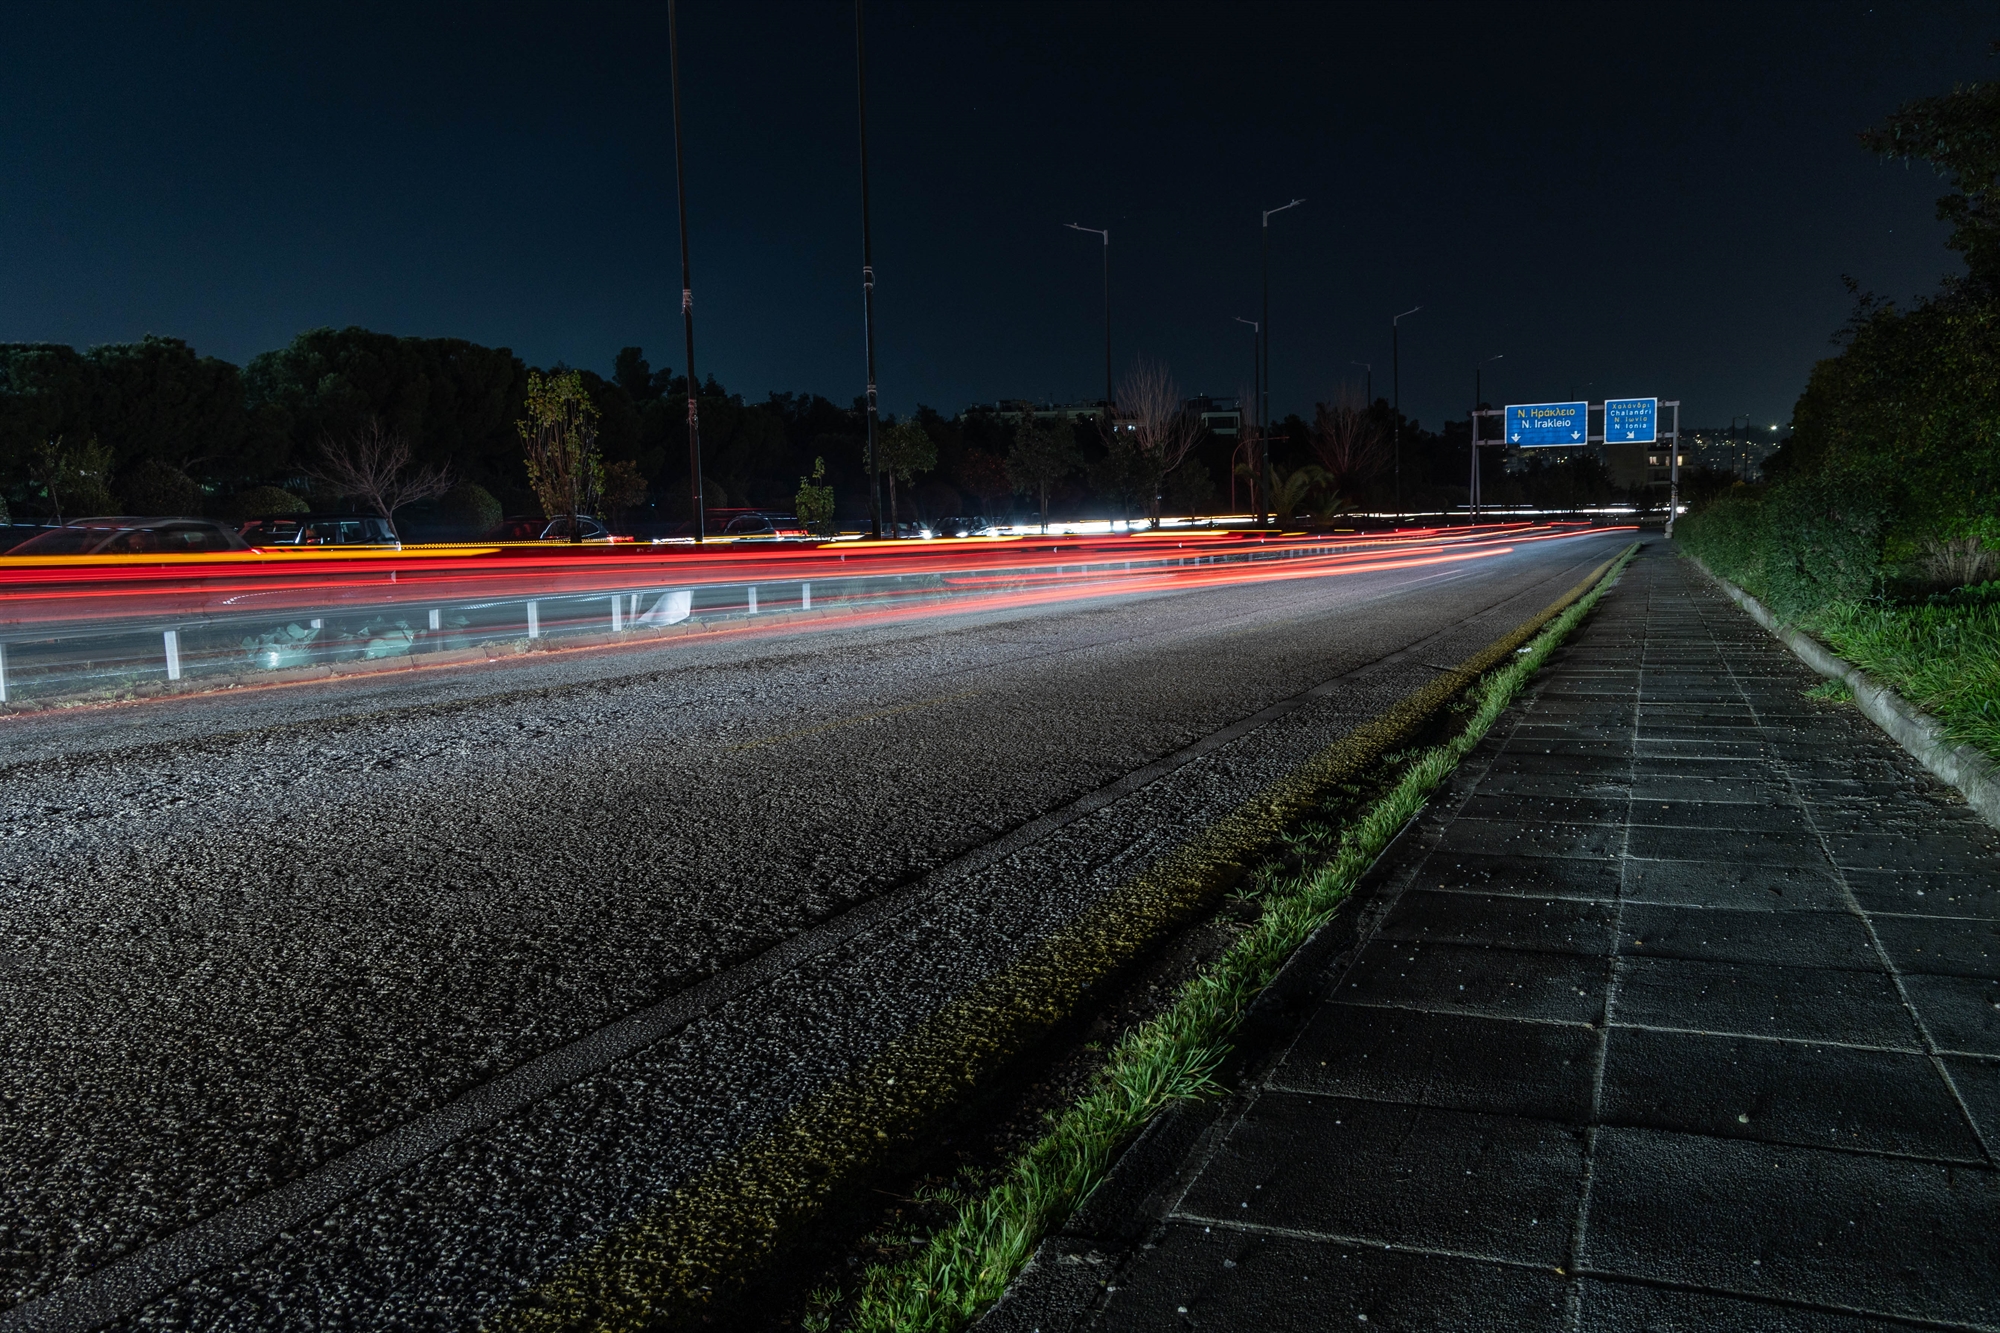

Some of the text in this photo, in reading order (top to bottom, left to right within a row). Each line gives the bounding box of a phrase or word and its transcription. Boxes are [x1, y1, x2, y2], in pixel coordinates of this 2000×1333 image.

[1612, 402, 1650, 410] Χαλάνδρι
[1517, 407, 1576, 419] Ν. Ηράκλειο
[1610, 408, 1652, 416] Chalandri
[1521, 418, 1571, 428] N. Irakleio
